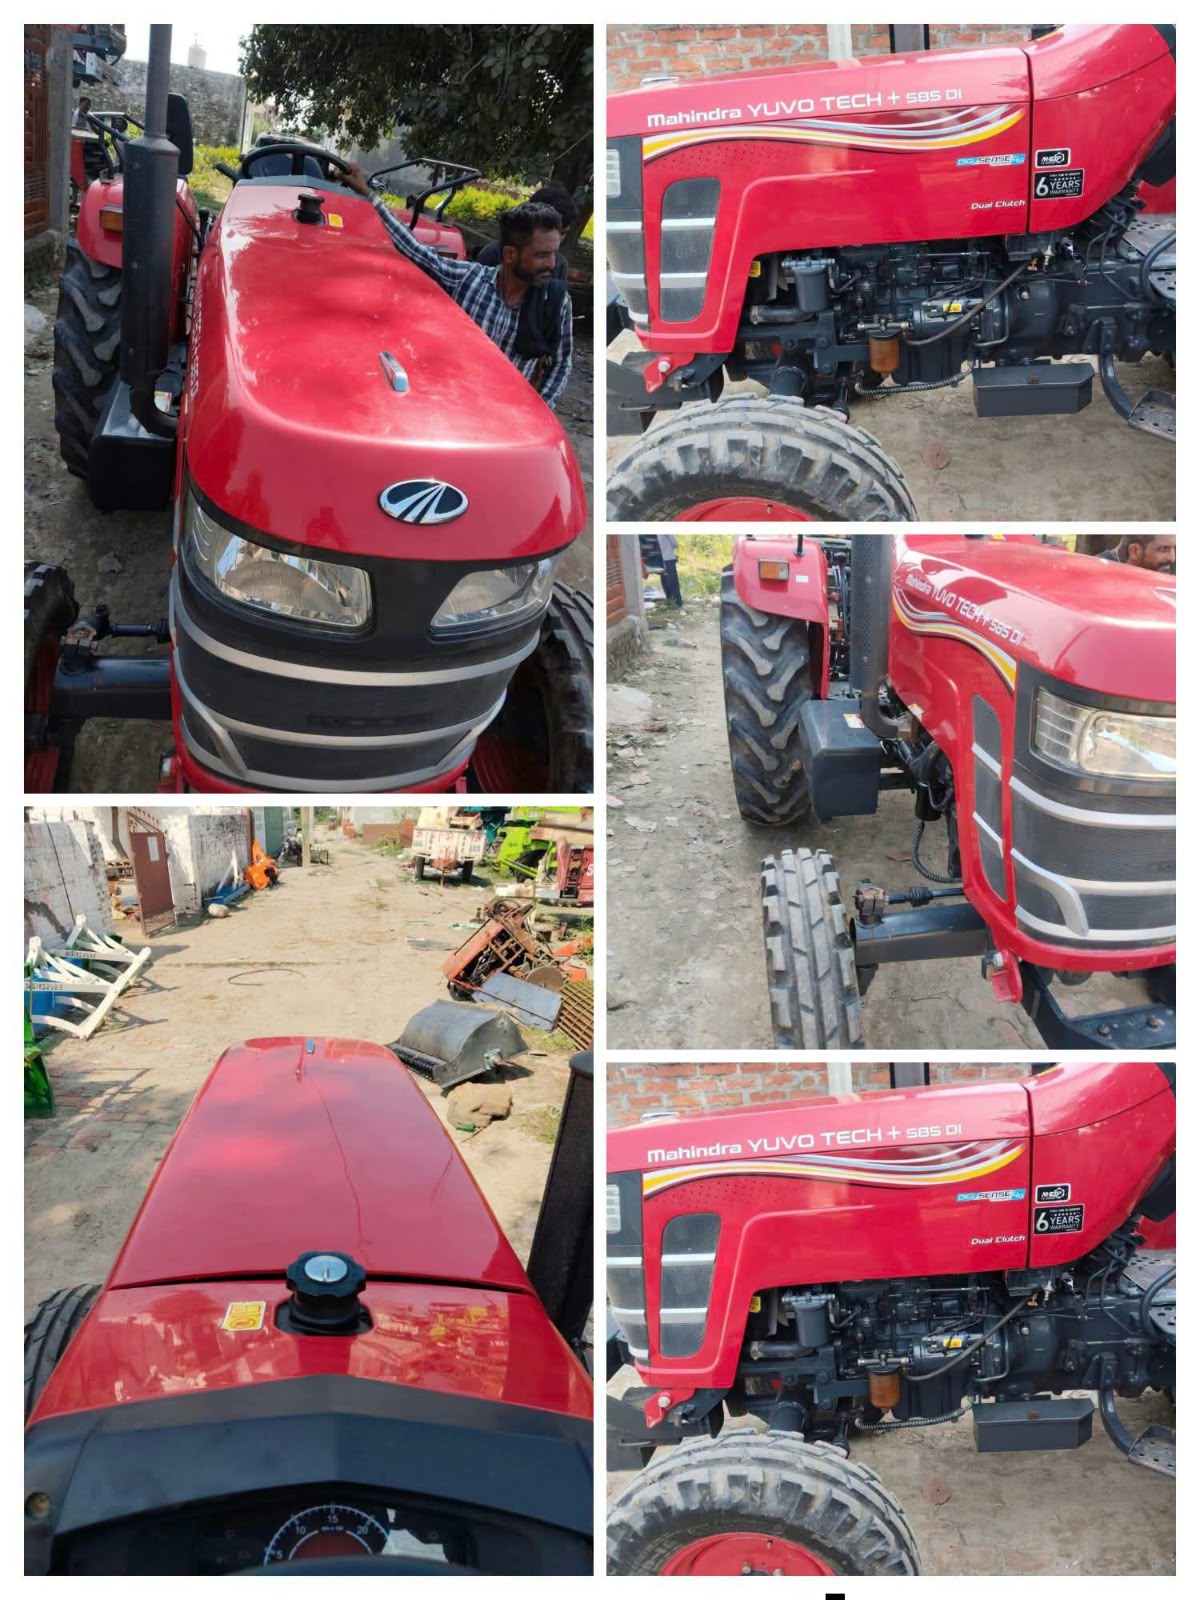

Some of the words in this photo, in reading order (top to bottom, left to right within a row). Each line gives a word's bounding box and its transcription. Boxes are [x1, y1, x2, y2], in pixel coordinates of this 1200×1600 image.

[647, 107, 742, 128] Mahindra
[748, 97, 815, 116] YUVO
[820, 92, 882, 111] TECH
[887, 92, 900, 105] +
[906, 90, 941, 104] 585
[946, 88, 963, 101] DI
[1036, 176, 1049, 196] 6
[1050, 180, 1080, 190] YEARS
[970, 202, 993, 210] Dual
[995, 199, 1026, 208] Clutch
[932, 587, 957, 608] YUVO
[989, 618, 1012, 639] 585
[647, 1142, 742, 1163] Mahindra
[748, 1132, 815, 1151] YUVO
[820, 1128, 882, 1146] TECH
[887, 1126, 900, 1140] +
[906, 1126, 941, 1139] 585
[946, 1124, 963, 1136] DI
[1036, 1212, 1049, 1232] 6
[1050, 1215, 1080, 1225] YEARS
[995, 1235, 1026, 1243] Clutch
[328, 1515, 339, 1523] 15
[296, 1526, 306, 1535] 10
[357, 1525, 369, 1535] 20
[276, 1551, 284, 1559] 5
